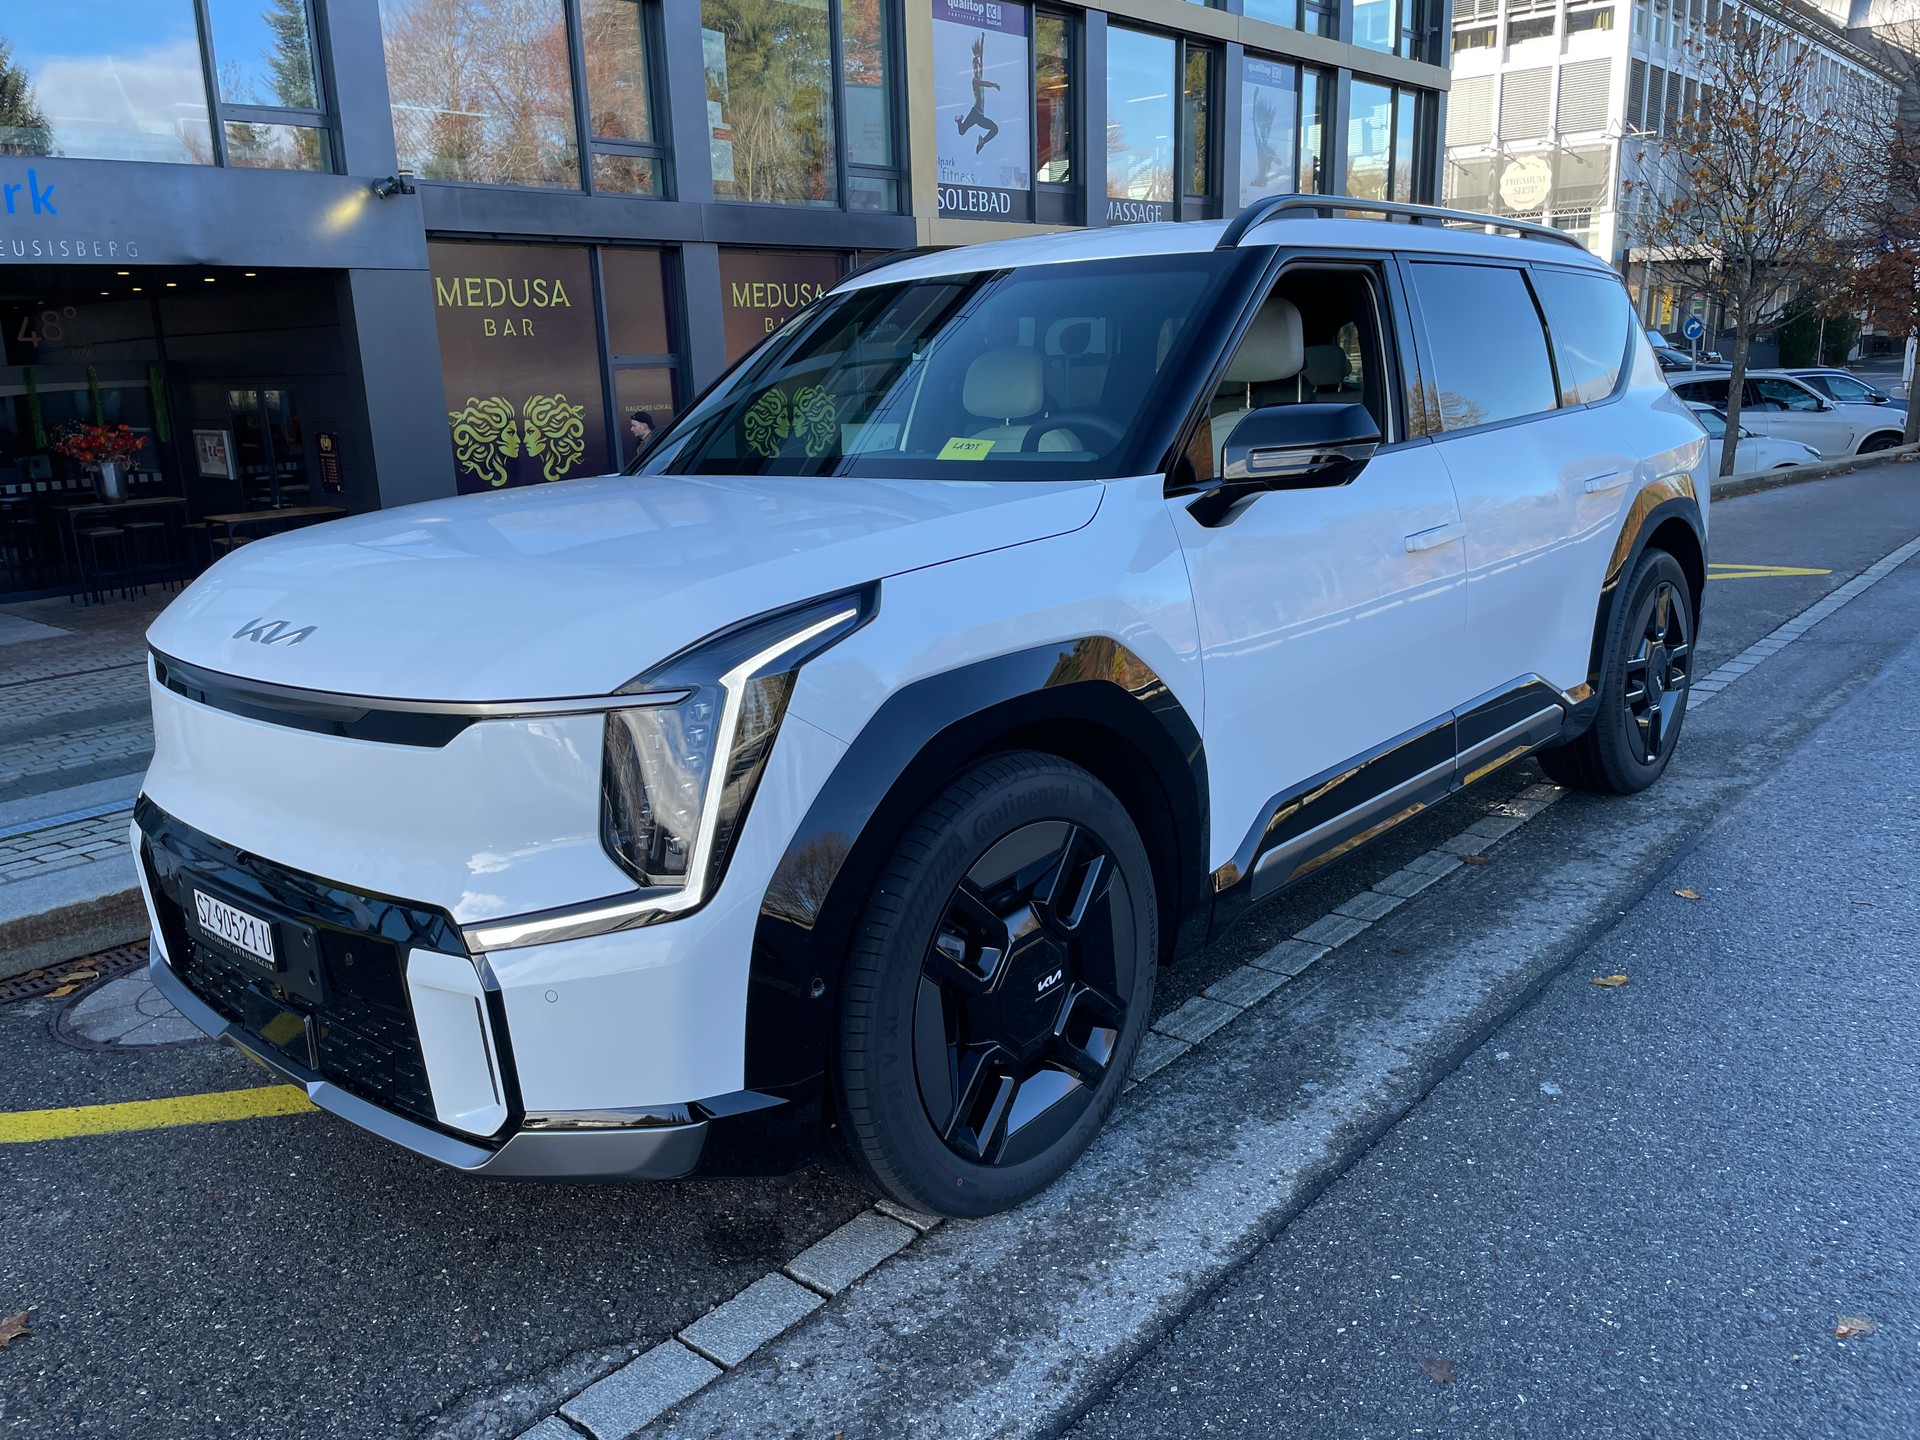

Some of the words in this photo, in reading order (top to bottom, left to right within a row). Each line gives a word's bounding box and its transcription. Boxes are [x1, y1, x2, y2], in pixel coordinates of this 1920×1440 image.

[942, 167, 975, 183] fitness
[938, 187, 1010, 213] SOLEBAD
[435, 277, 571, 308] MEDUSA
[484, 319, 534, 336] BAR
[232, 617, 319, 647] KIA
[972, 784, 1070, 844] Continental
[1038, 970, 1062, 991] KIA
